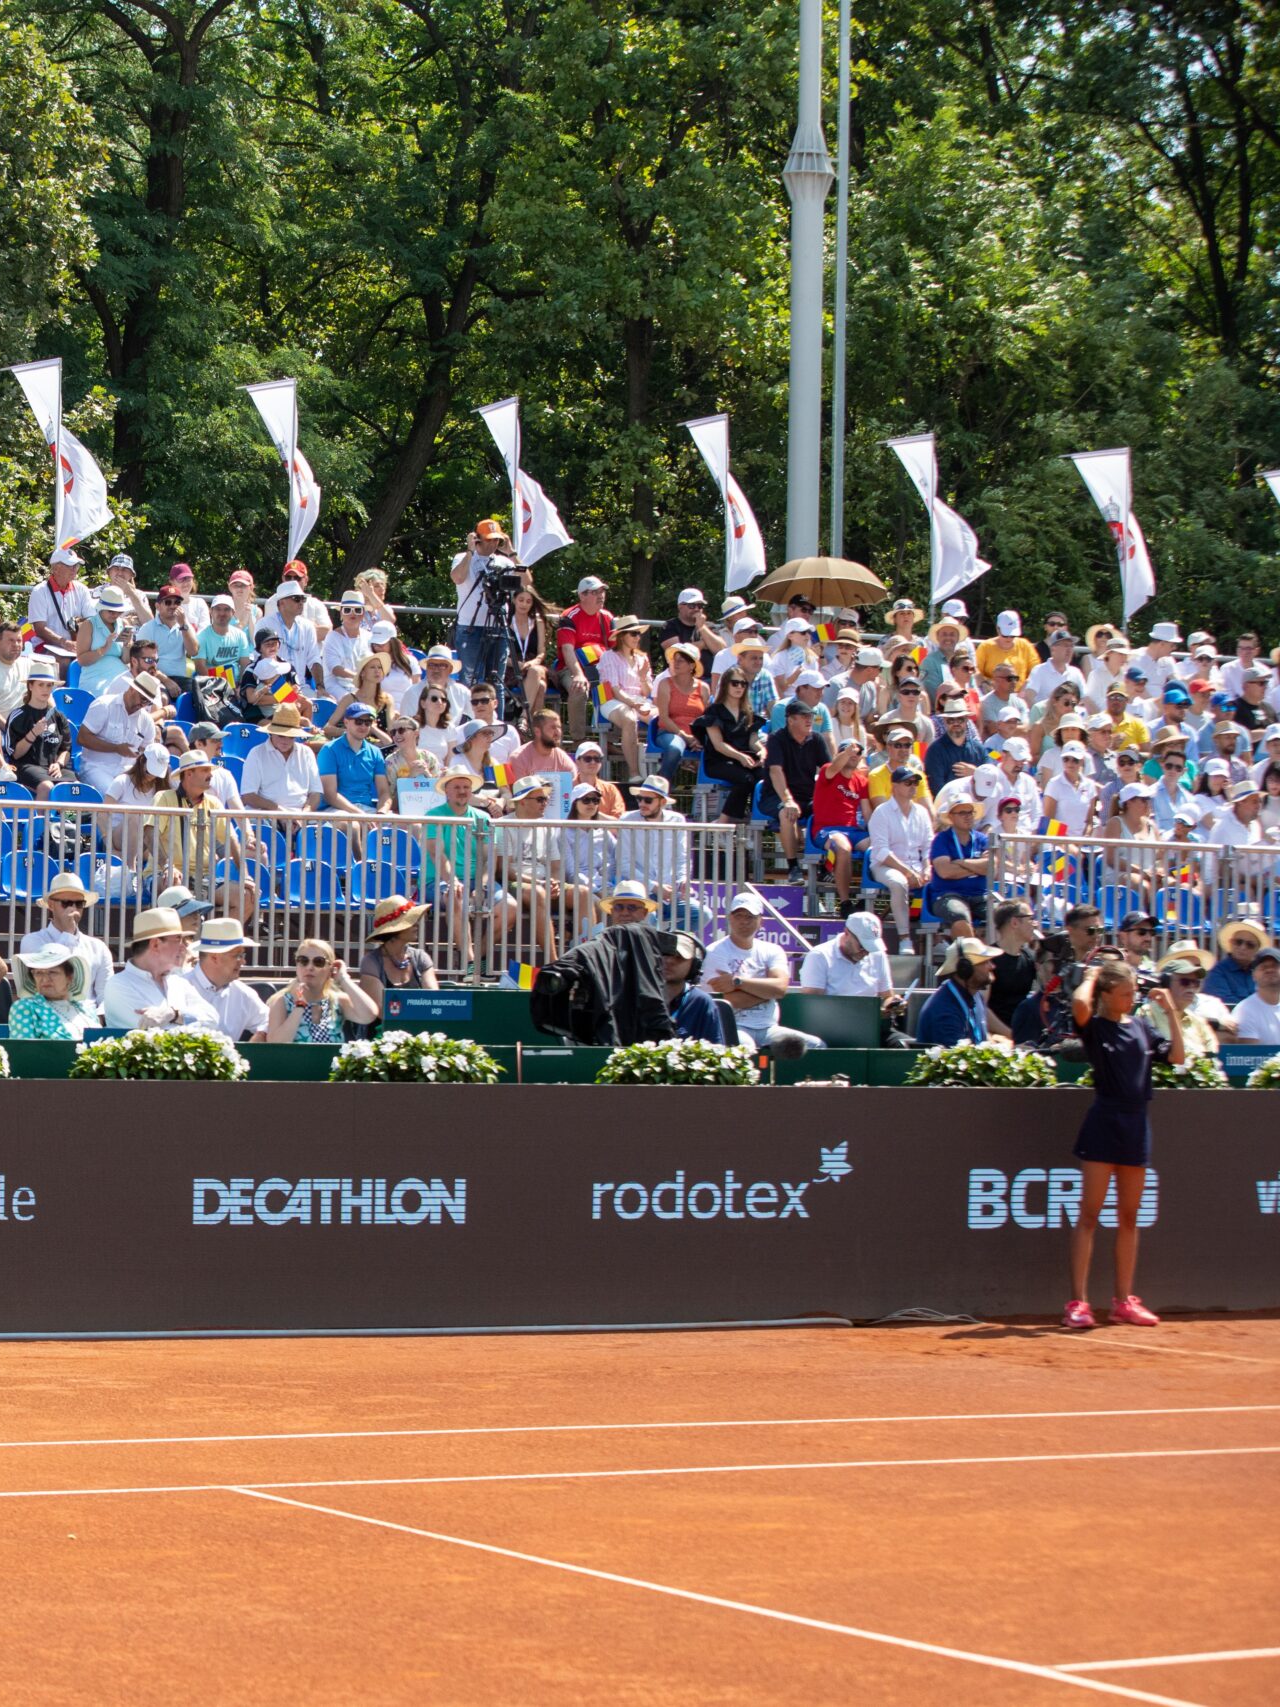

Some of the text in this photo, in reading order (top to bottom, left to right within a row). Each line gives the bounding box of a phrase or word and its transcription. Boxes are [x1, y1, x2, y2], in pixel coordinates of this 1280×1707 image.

[216, 646, 239, 658] NIKE
[755, 928, 790, 945] ând
[193, 1178, 467, 1225] DECATHLON
[592, 1170, 810, 1220] rodotex
[968, 1168, 1084, 1229] BCR
